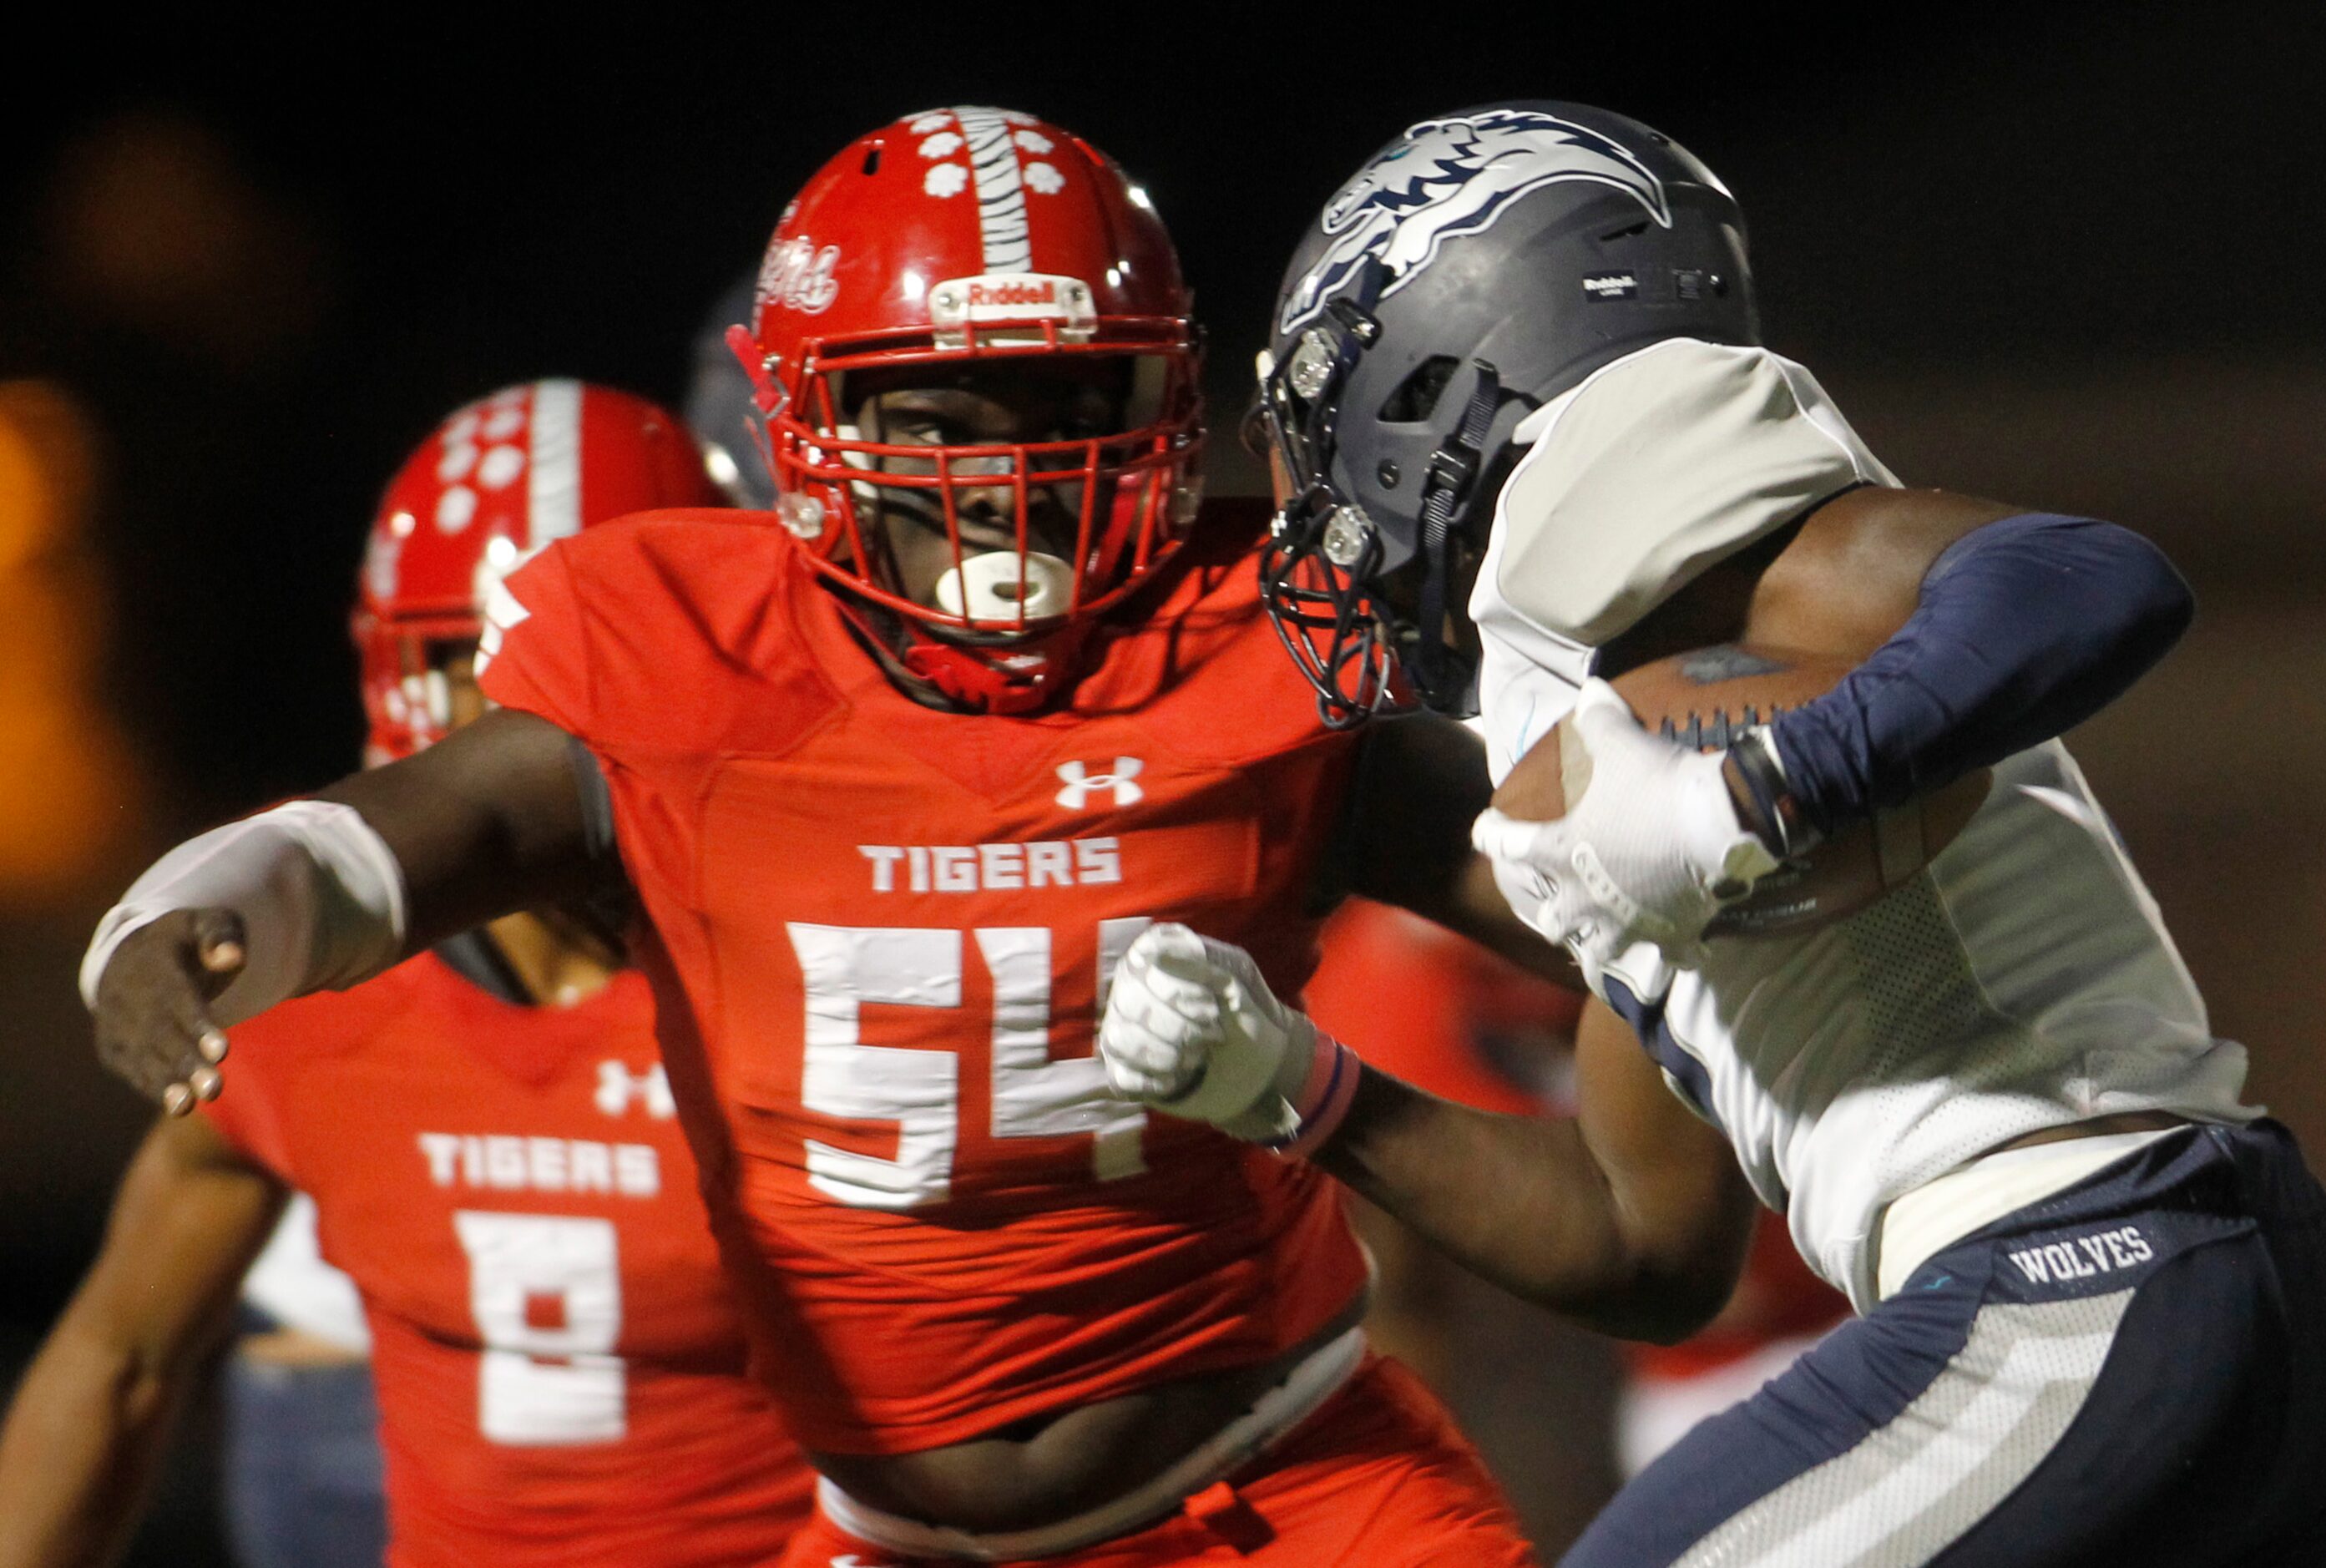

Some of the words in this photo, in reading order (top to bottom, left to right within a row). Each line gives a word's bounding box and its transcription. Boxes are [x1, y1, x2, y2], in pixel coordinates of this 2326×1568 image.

[968, 281, 1055, 306] Riddell
[857, 837, 1122, 893] TIGERS
[786, 917, 1154, 1210] 54
[417, 1132, 660, 1198] TIGERS
[2009, 1226, 2153, 1283] WOLVES
[453, 1210, 628, 1445] 8
